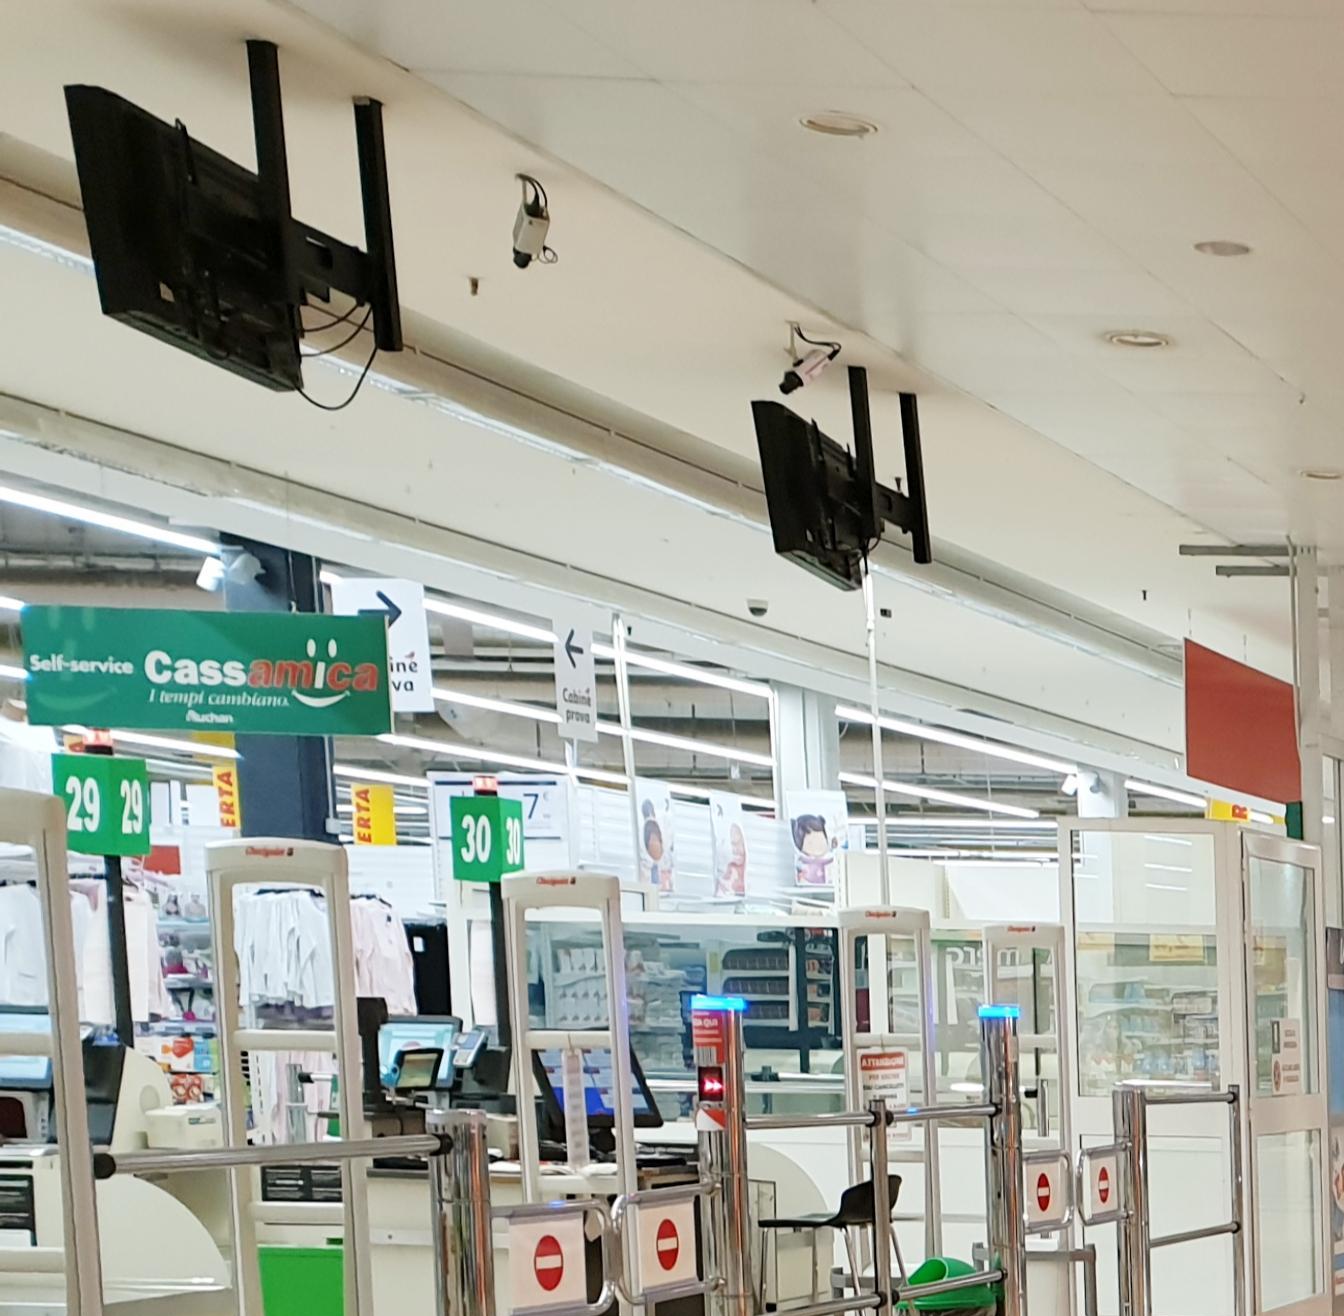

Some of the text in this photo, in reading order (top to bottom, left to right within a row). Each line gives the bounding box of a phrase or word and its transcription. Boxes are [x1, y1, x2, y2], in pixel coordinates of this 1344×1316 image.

[29, 649, 379, 692] Self-service Cassamica
[158, 689, 205, 708] tempi
[185, 708, 235, 724] Auchan
[65, 775, 101, 833] 29
[120, 779, 143, 834] 29
[460, 813, 492, 864] 30
[505, 816, 521, 865] 30
